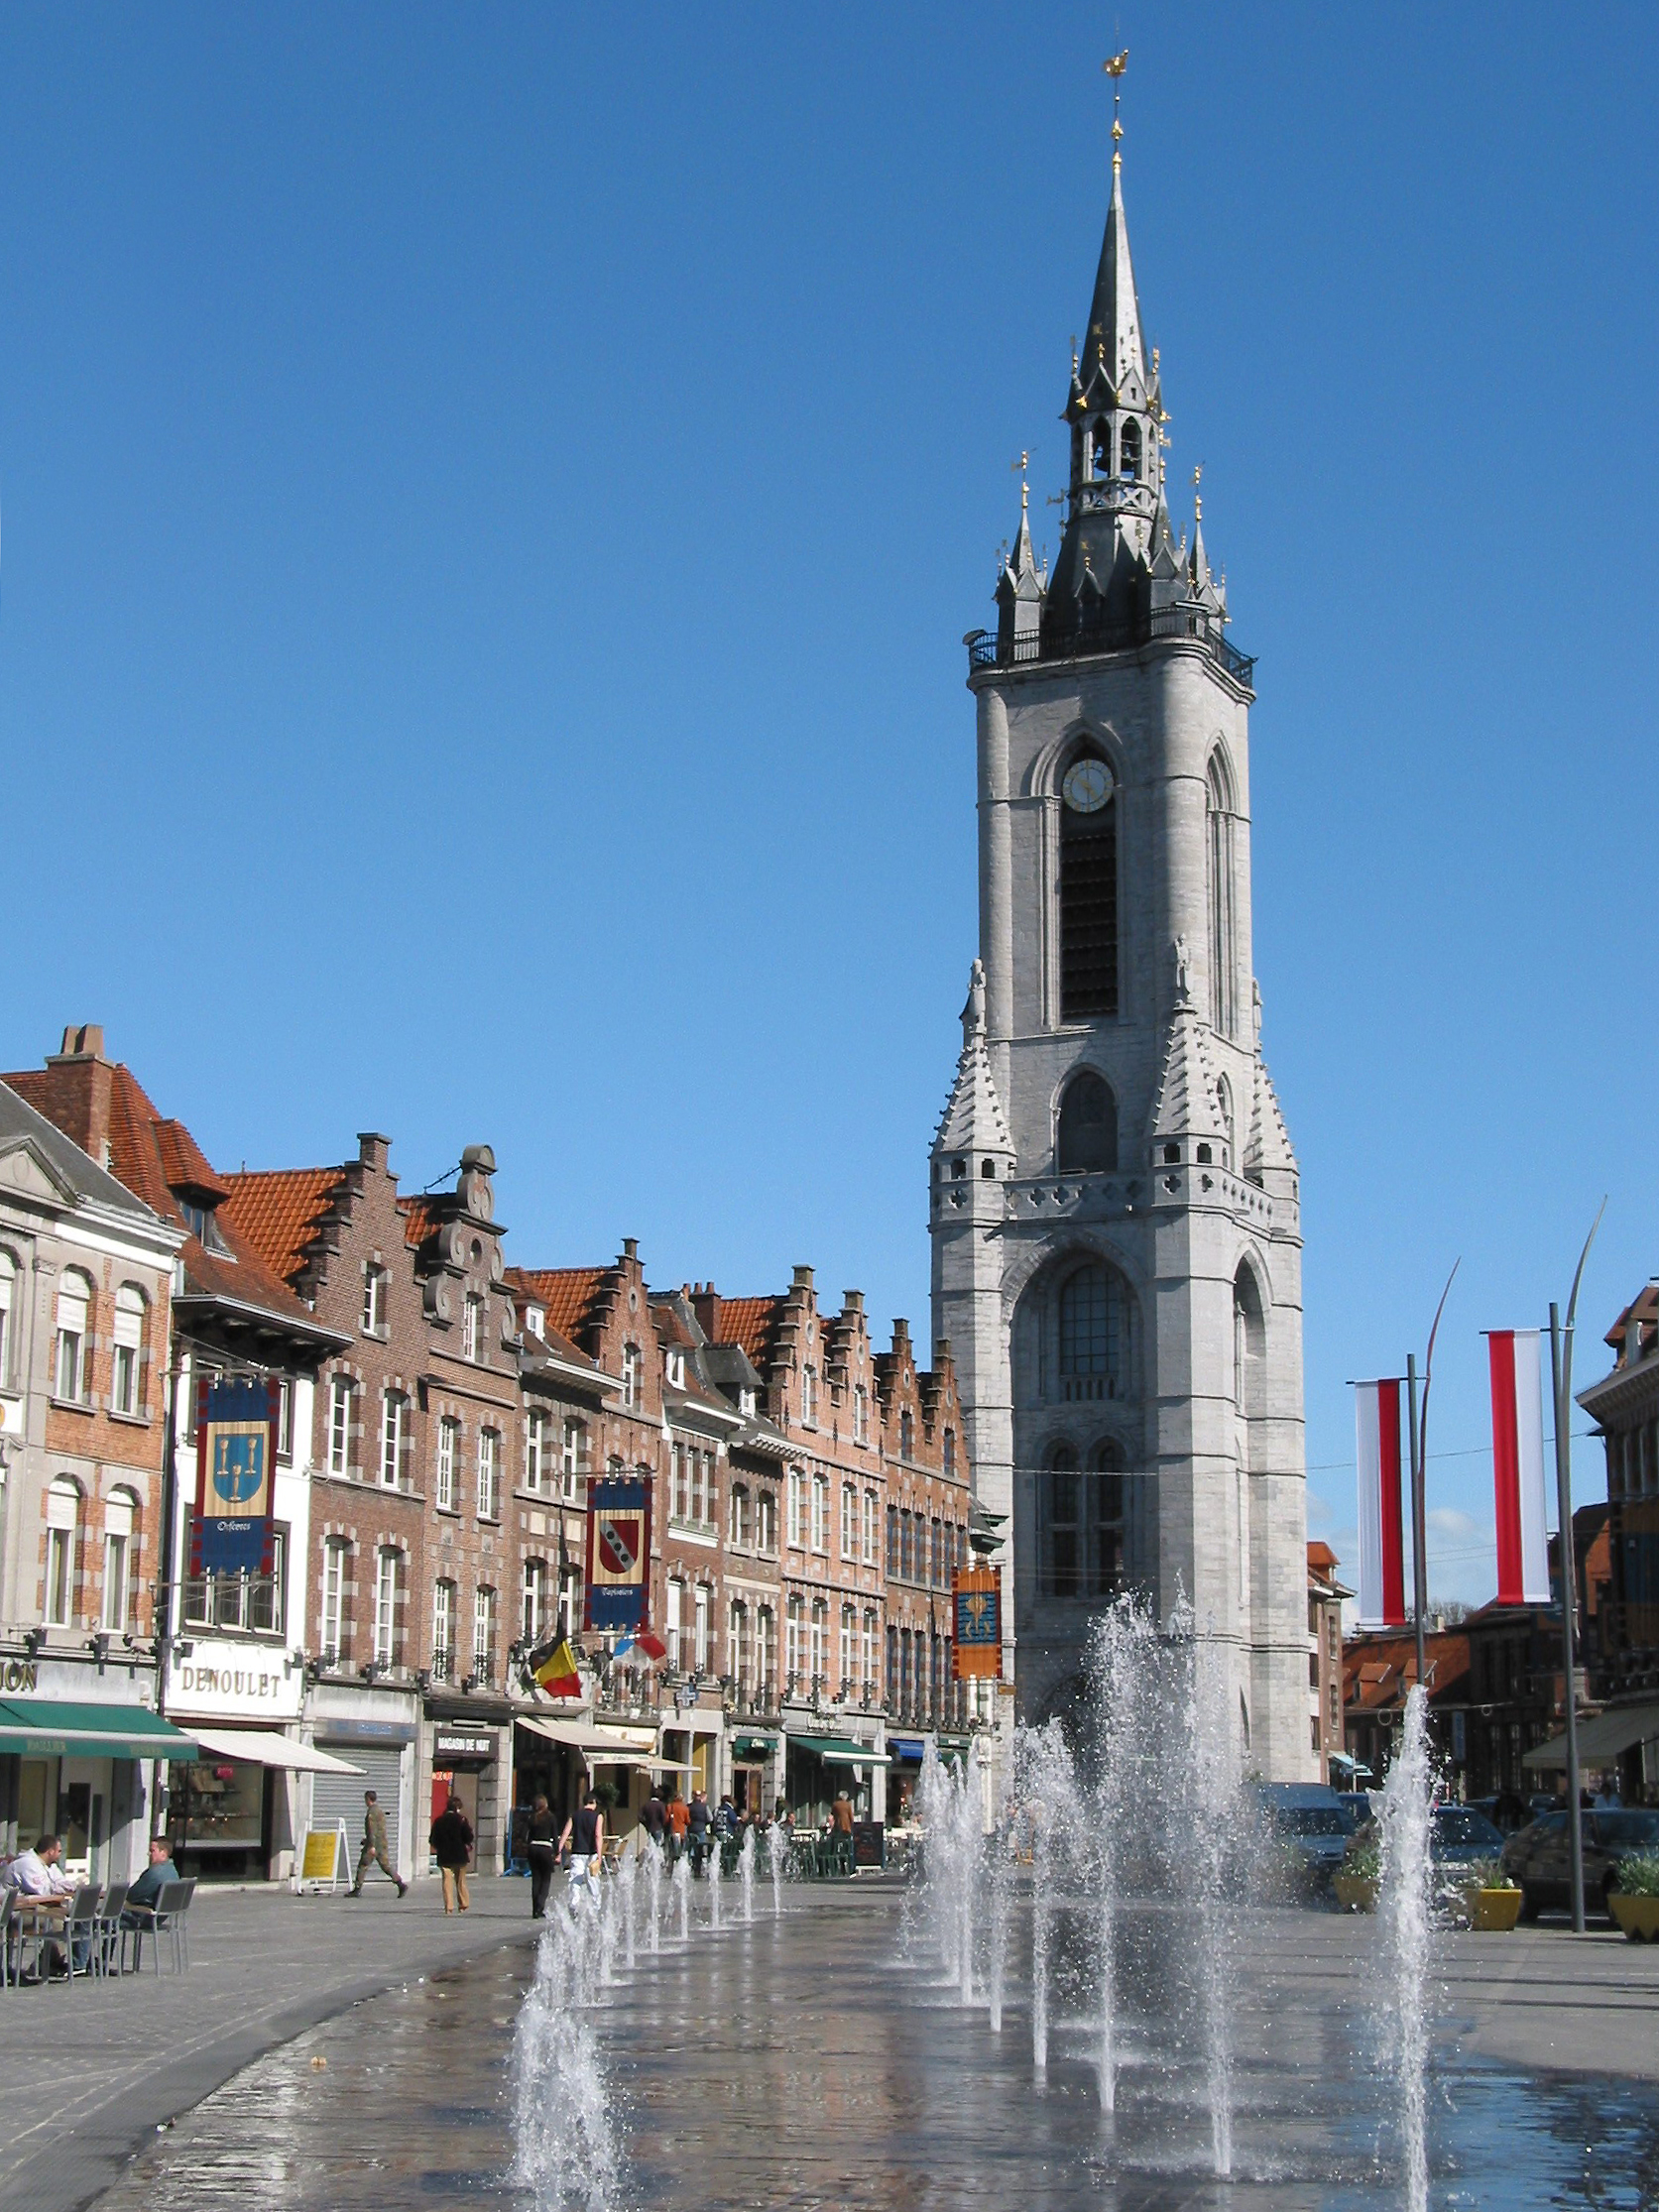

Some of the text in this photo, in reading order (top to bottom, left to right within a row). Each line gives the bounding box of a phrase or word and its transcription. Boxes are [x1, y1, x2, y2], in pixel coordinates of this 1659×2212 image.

[181, 1666, 281, 1698] DENOULET
[437, 1736, 491, 1753] MAGASIN DE NUIT
